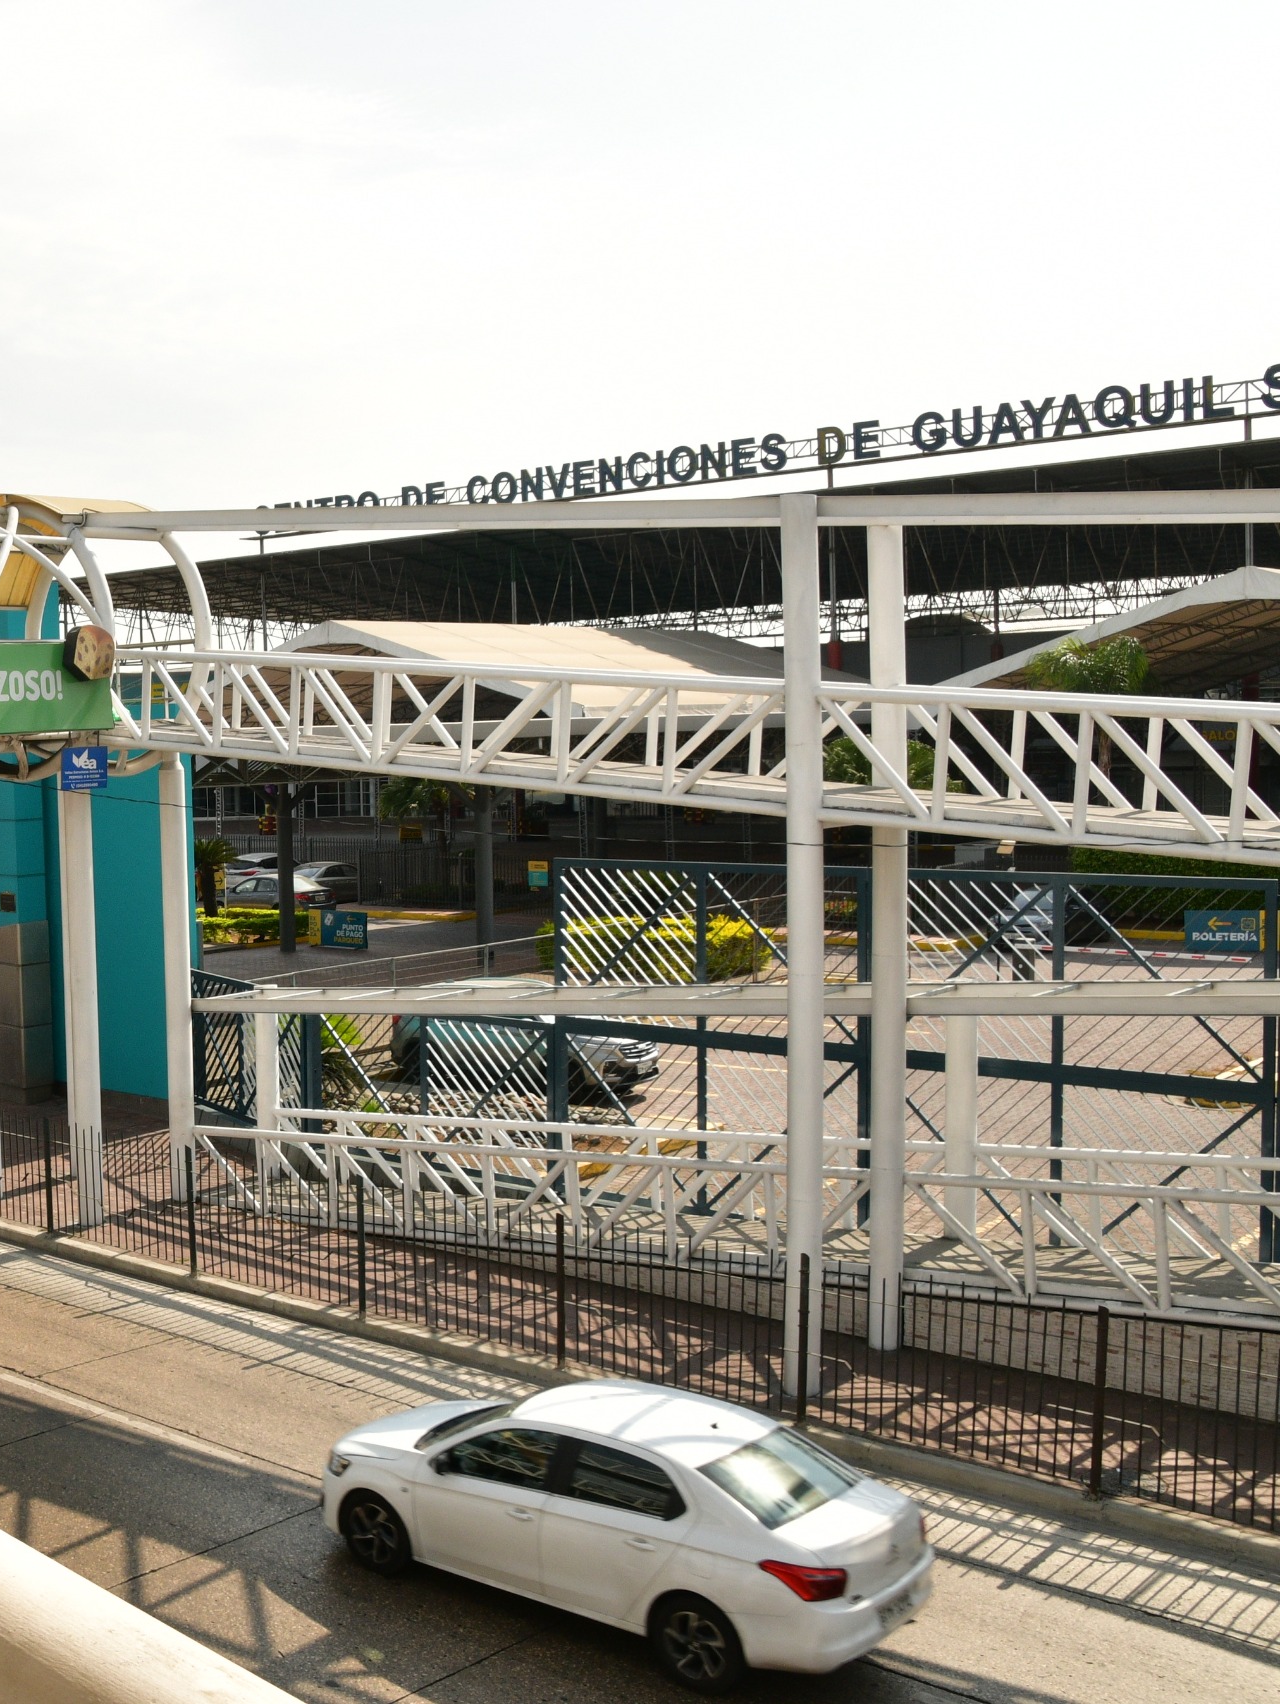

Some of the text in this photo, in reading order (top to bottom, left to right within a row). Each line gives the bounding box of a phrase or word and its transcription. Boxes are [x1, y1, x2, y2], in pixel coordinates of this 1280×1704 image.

[467, 432, 788, 504] CONVENCIONES
[817, 420, 881, 464] DE
[911, 375, 1235, 452] GUAYAQUIL
[1192, 930, 1258, 941] BOLETERÍA
